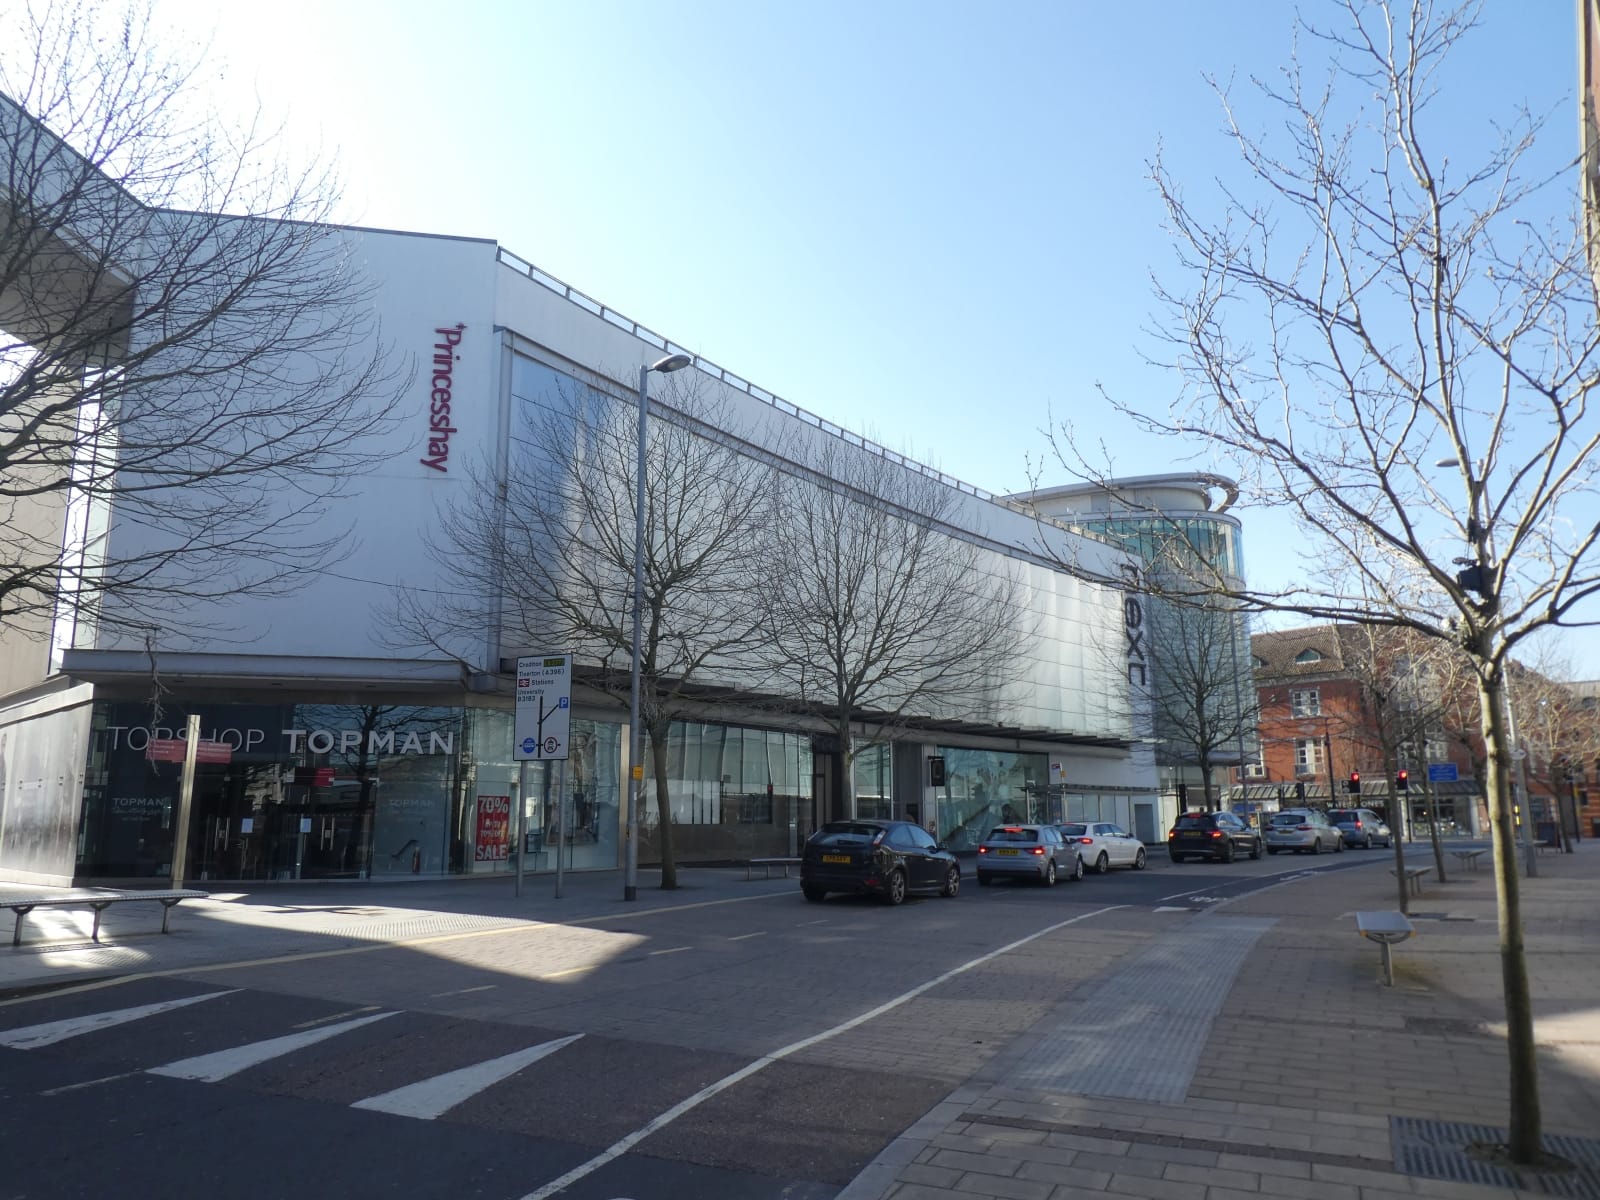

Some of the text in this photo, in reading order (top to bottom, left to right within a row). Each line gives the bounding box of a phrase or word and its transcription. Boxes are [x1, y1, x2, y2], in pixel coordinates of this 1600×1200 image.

[420, 327, 461, 472] Princesshay
[282, 729, 455, 755] TOPMAN
[112, 797, 163, 806] TOPMAN
[479, 797, 508, 814] 70%
[477, 845, 506, 860] SALE
